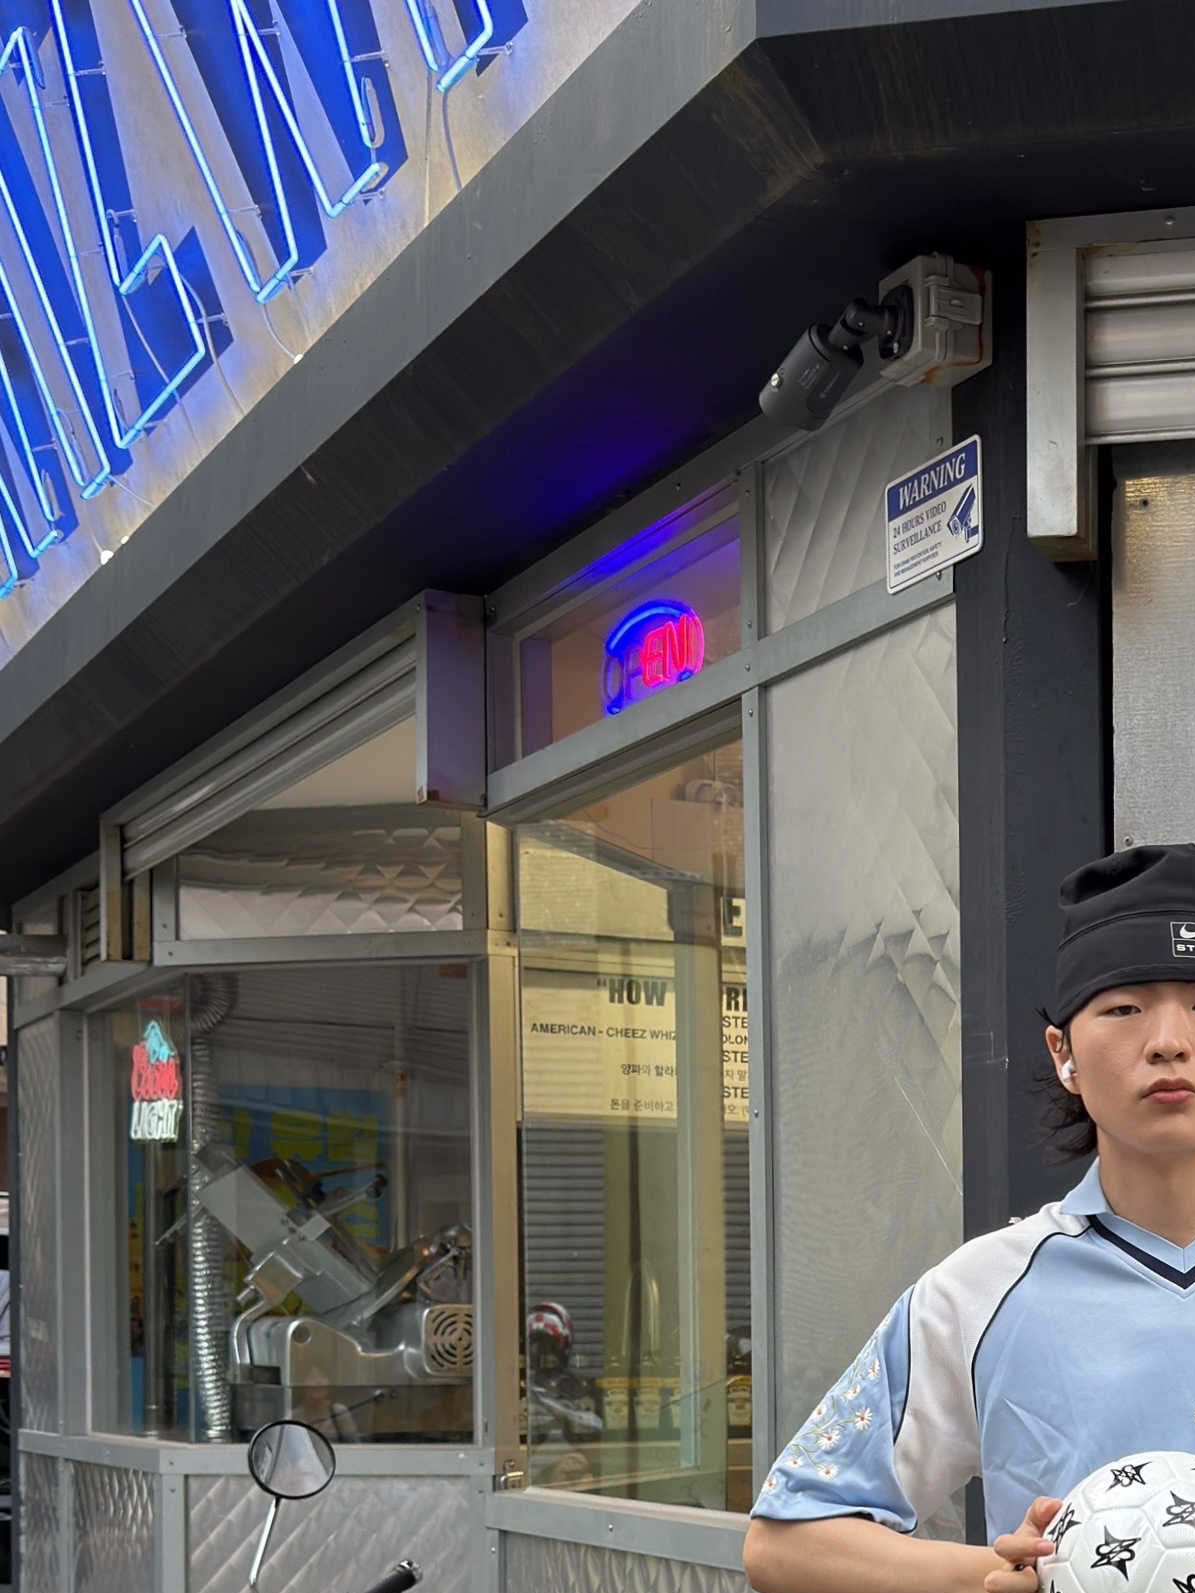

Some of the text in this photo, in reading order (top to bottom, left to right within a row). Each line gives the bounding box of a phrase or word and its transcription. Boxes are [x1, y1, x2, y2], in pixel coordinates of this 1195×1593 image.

[899, 452, 966, 511] WARNING
[893, 501, 946, 539] 24 HOURS VIDEO
[893, 520, 942, 555] SURVEILLANCE
[530, 1022, 596, 1037] AMERICAN
[606, 1026, 647, 1039] CHEEZ
[621, 1063, 651, 1077] 양파와
[633, 1099, 674, 1113] 준비하고
